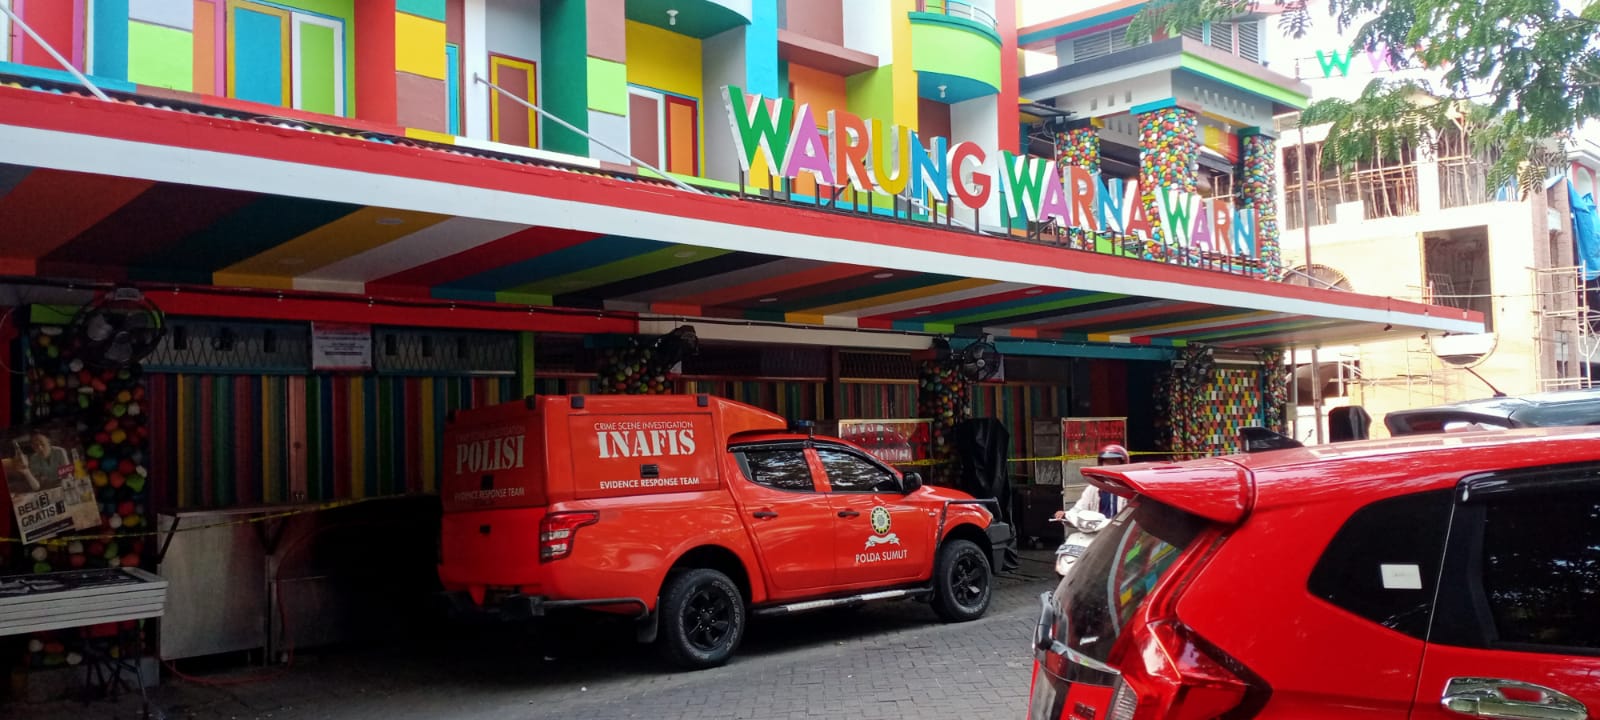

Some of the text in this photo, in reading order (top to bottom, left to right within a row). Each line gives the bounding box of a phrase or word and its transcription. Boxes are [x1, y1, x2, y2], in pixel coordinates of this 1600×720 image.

[721, 85, 991, 208] WARUNG
[998, 150, 1154, 239] WARNA
[594, 420, 694, 431] CRIME SCENE INVESTIGATION
[597, 429, 696, 459] INAFIS
[456, 435, 525, 475] POLISI
[508, 485, 526, 498] TEAM
[600, 476, 700, 490] EVIDENCE RESPONSE TEAM
[22, 507, 55, 527] GRATIS
[855, 549, 908, 564] POLDA SUMUT
